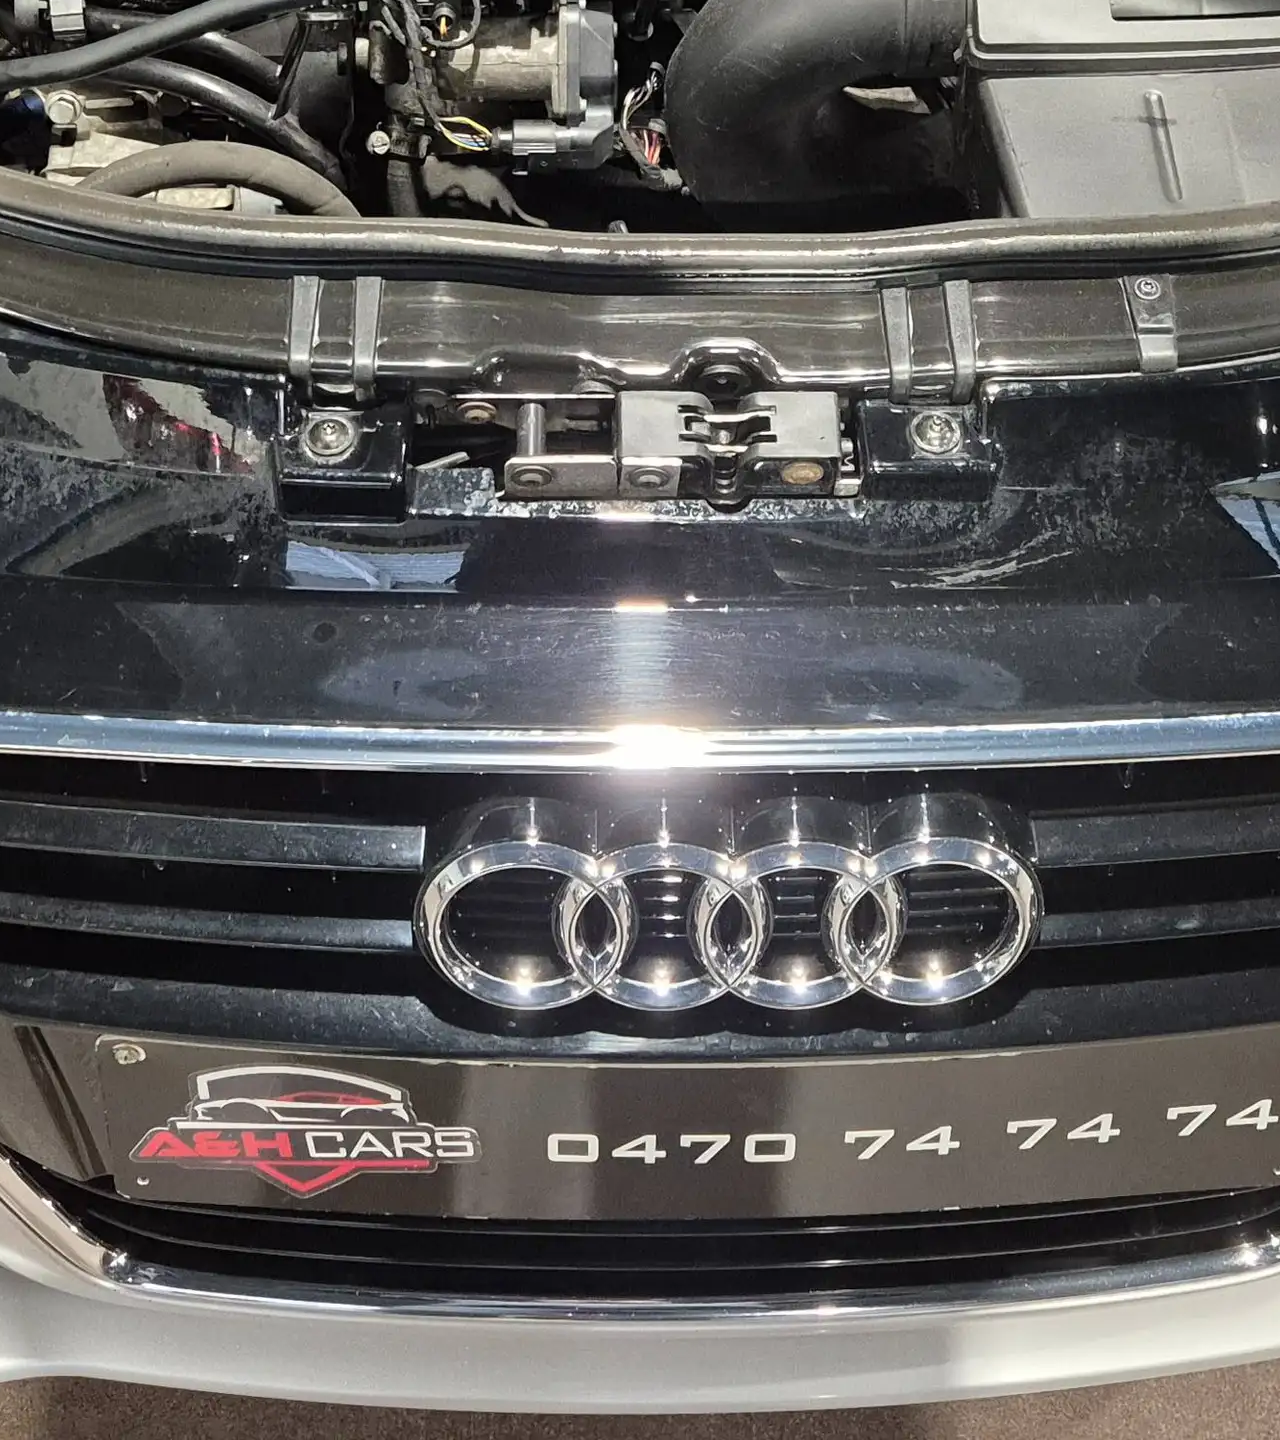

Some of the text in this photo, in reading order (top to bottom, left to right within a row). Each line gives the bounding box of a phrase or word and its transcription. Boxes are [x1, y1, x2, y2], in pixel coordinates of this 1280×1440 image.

[138, 1130, 475, 1159] A&H CARS
[547, 1098, 1280, 1165] 0470 74 74 74
